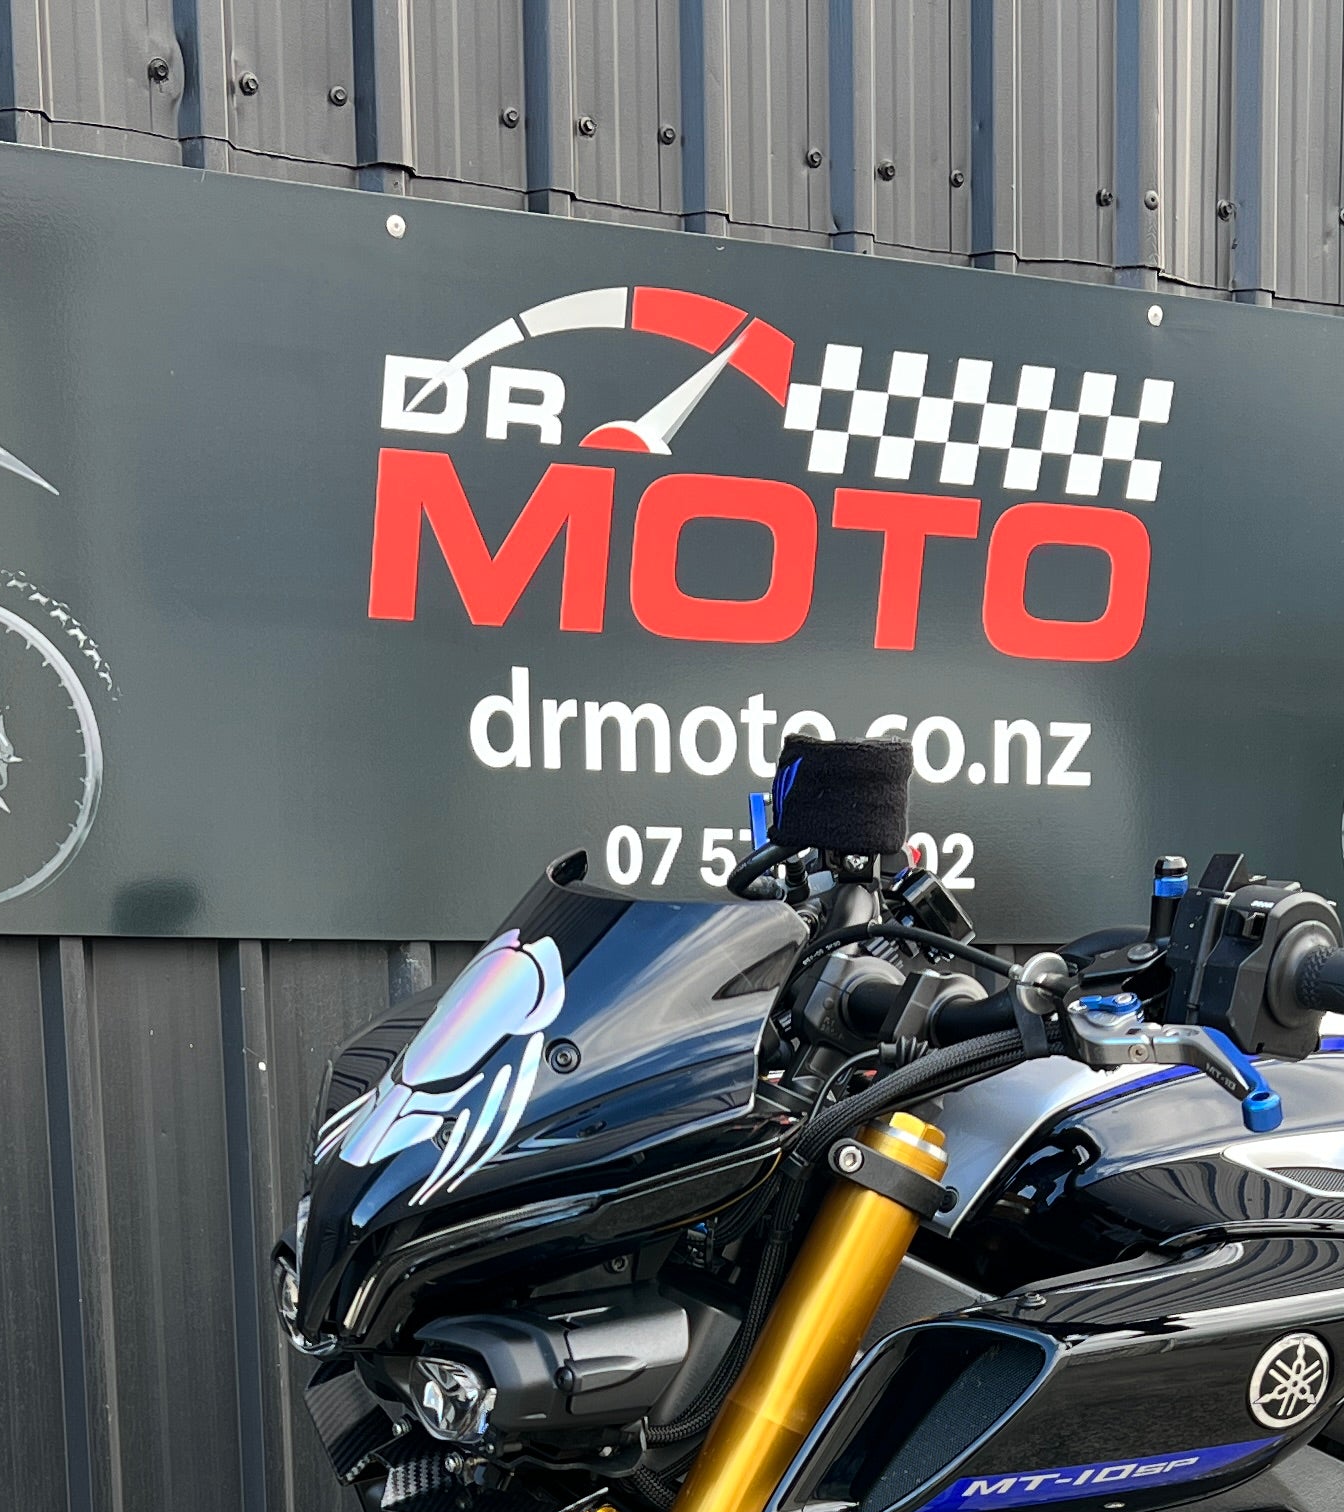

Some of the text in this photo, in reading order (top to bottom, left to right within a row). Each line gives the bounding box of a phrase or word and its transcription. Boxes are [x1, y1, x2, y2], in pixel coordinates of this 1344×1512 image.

[381, 353, 568, 445] DR
[367, 446, 1153, 663] MOTO
[606, 824, 683, 886] 07
